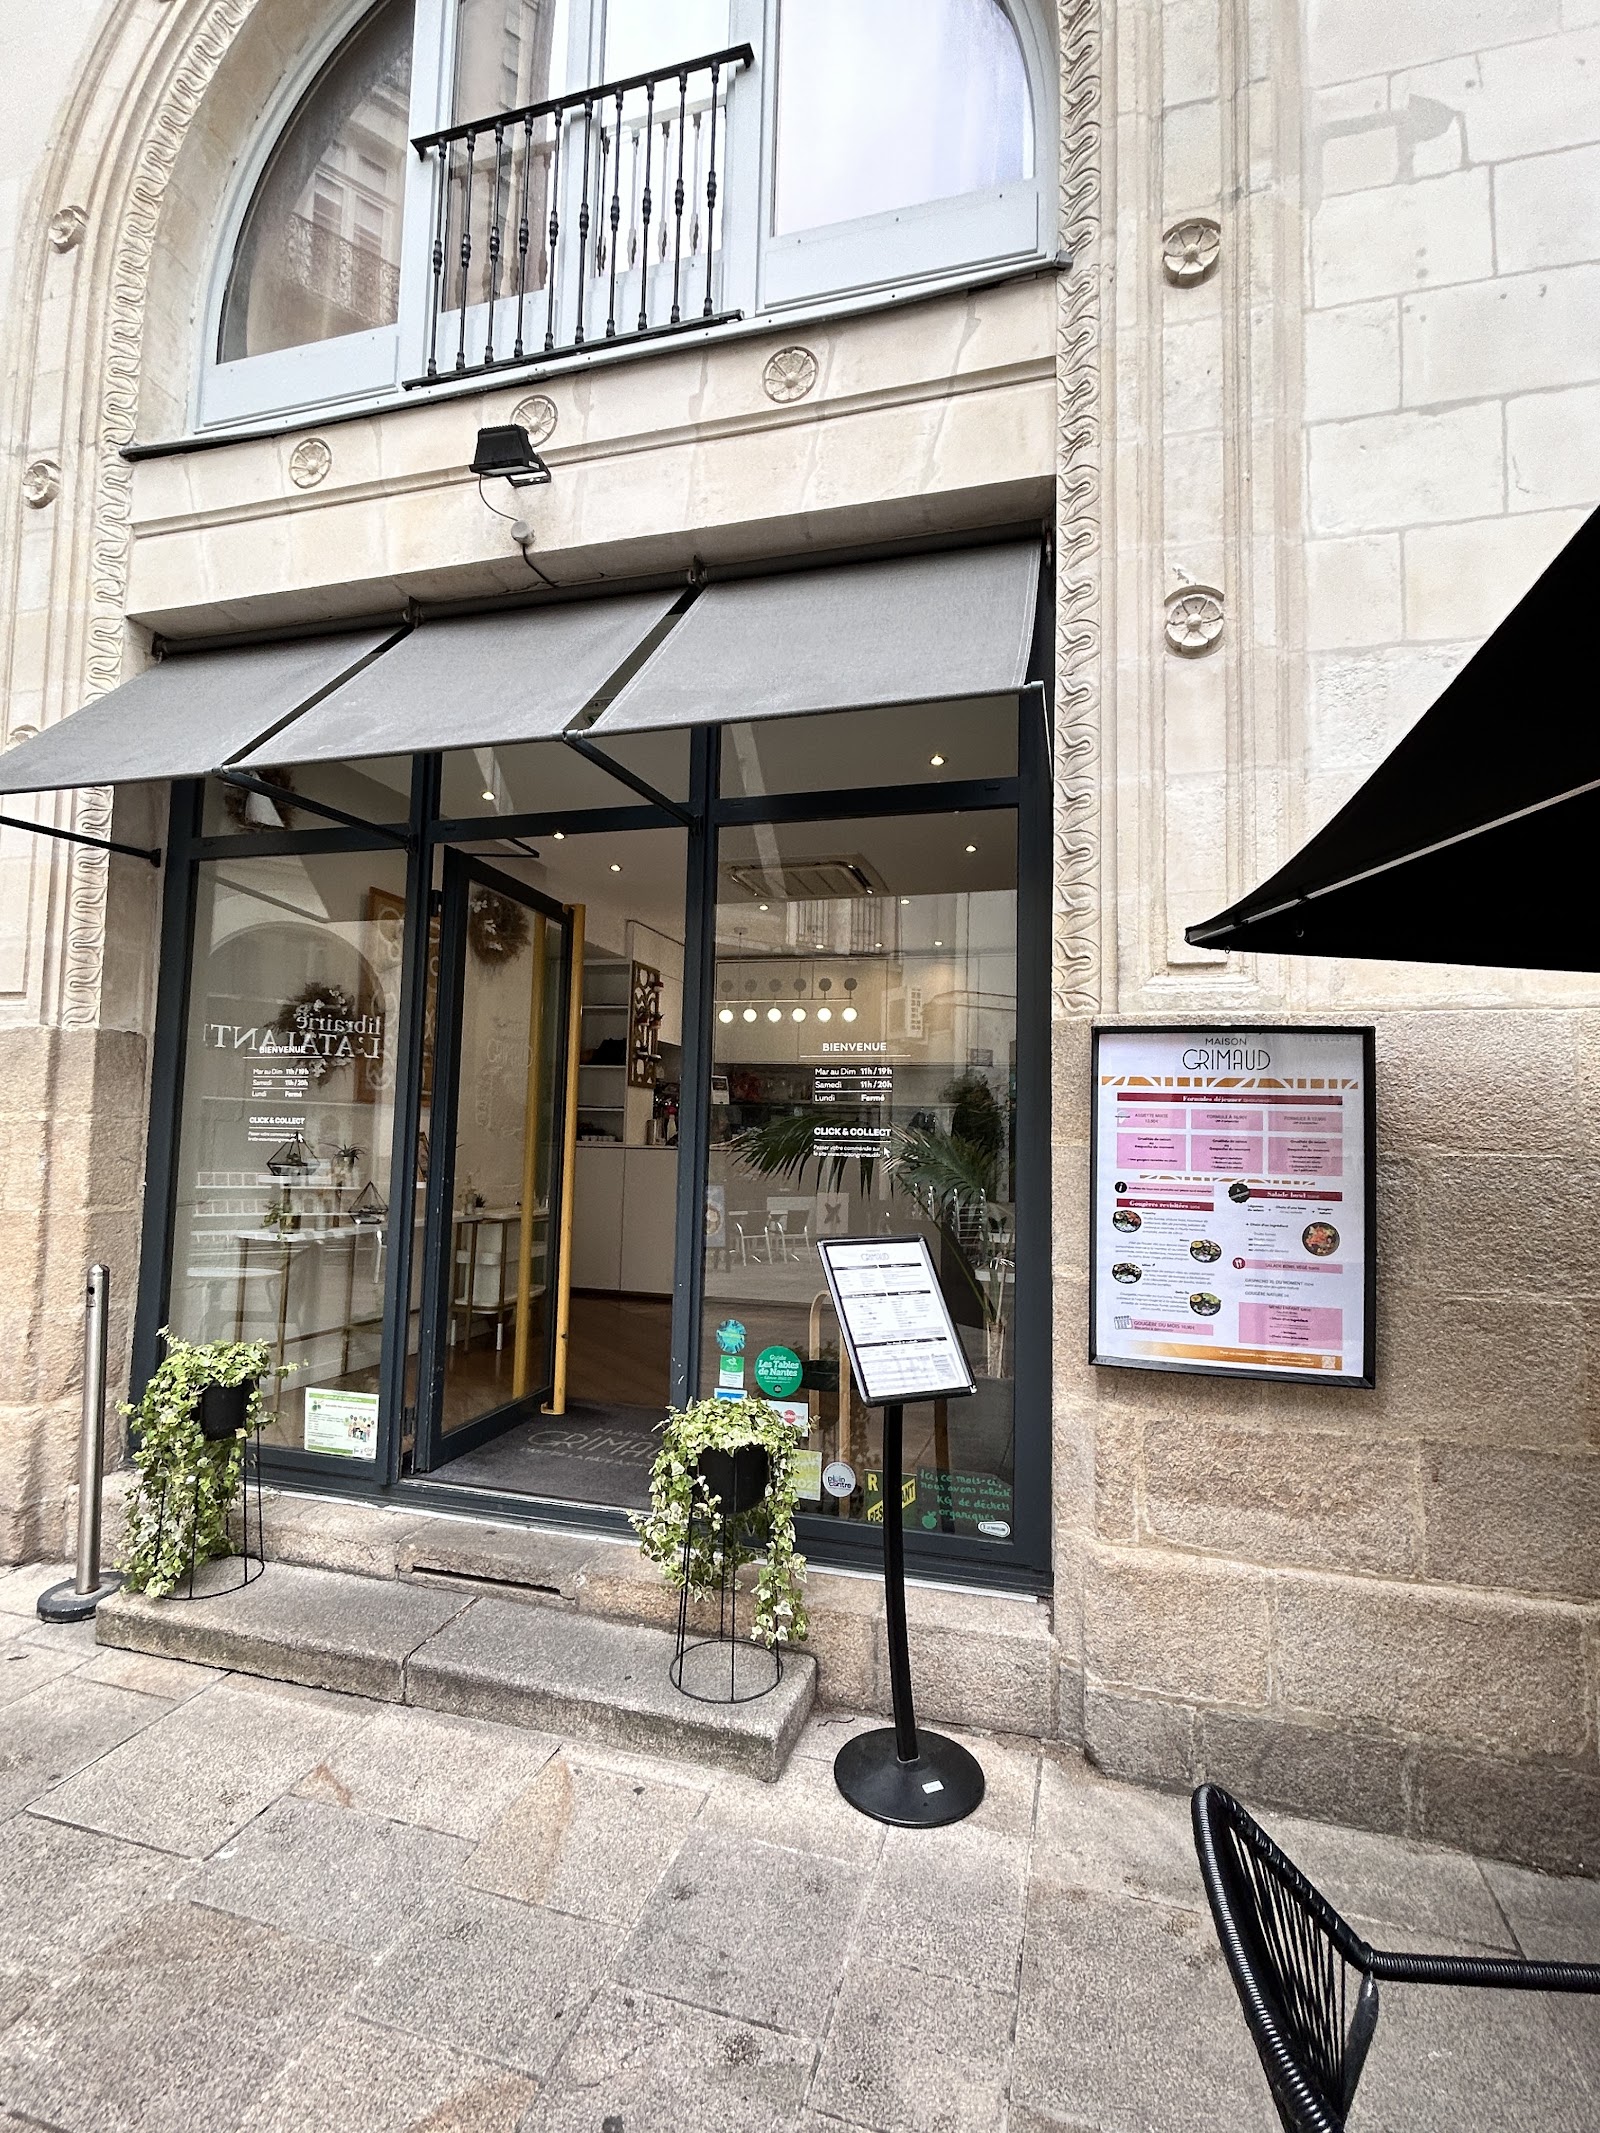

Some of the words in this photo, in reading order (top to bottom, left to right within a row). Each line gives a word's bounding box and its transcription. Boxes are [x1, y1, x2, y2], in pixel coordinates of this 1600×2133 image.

[1205, 1037, 1247, 1046] MAISON
[259, 1045, 306, 1054] BIENVENUE
[822, 1042, 887, 1052] BIENVENUE
[1182, 1048, 1271, 1071] GRIMAUD
[840, 1067, 857, 1075] Dim
[815, 1081, 842, 1089] Samedi
[814, 1094, 836, 1102] Lundi
[861, 1093, 885, 1102] Fermé
[249, 1116, 269, 1124] CLICK
[275, 1116, 305, 1125] COLLECT
[813, 1127, 841, 1136] CLICK
[842, 1127, 849, 1136] &
[849, 1128, 891, 1137] COLLECT
[758, 1360, 773, 1368] Les
[773, 1360, 799, 1369] Tables
[758, 1367, 769, 1376] de
[769, 1368, 798, 1377] Nantes
[527, 1431, 664, 1460] GRIMAU
[868, 1473, 879, 1492] R
[940, 1474, 953, 1482] ce
[920, 1481, 945, 1491] nous
[947, 1486, 977, 1494] avons
[958, 1498, 970, 1507] de
[973, 1499, 1010, 1511] déchets
[938, 1508, 997, 1523] organiques
